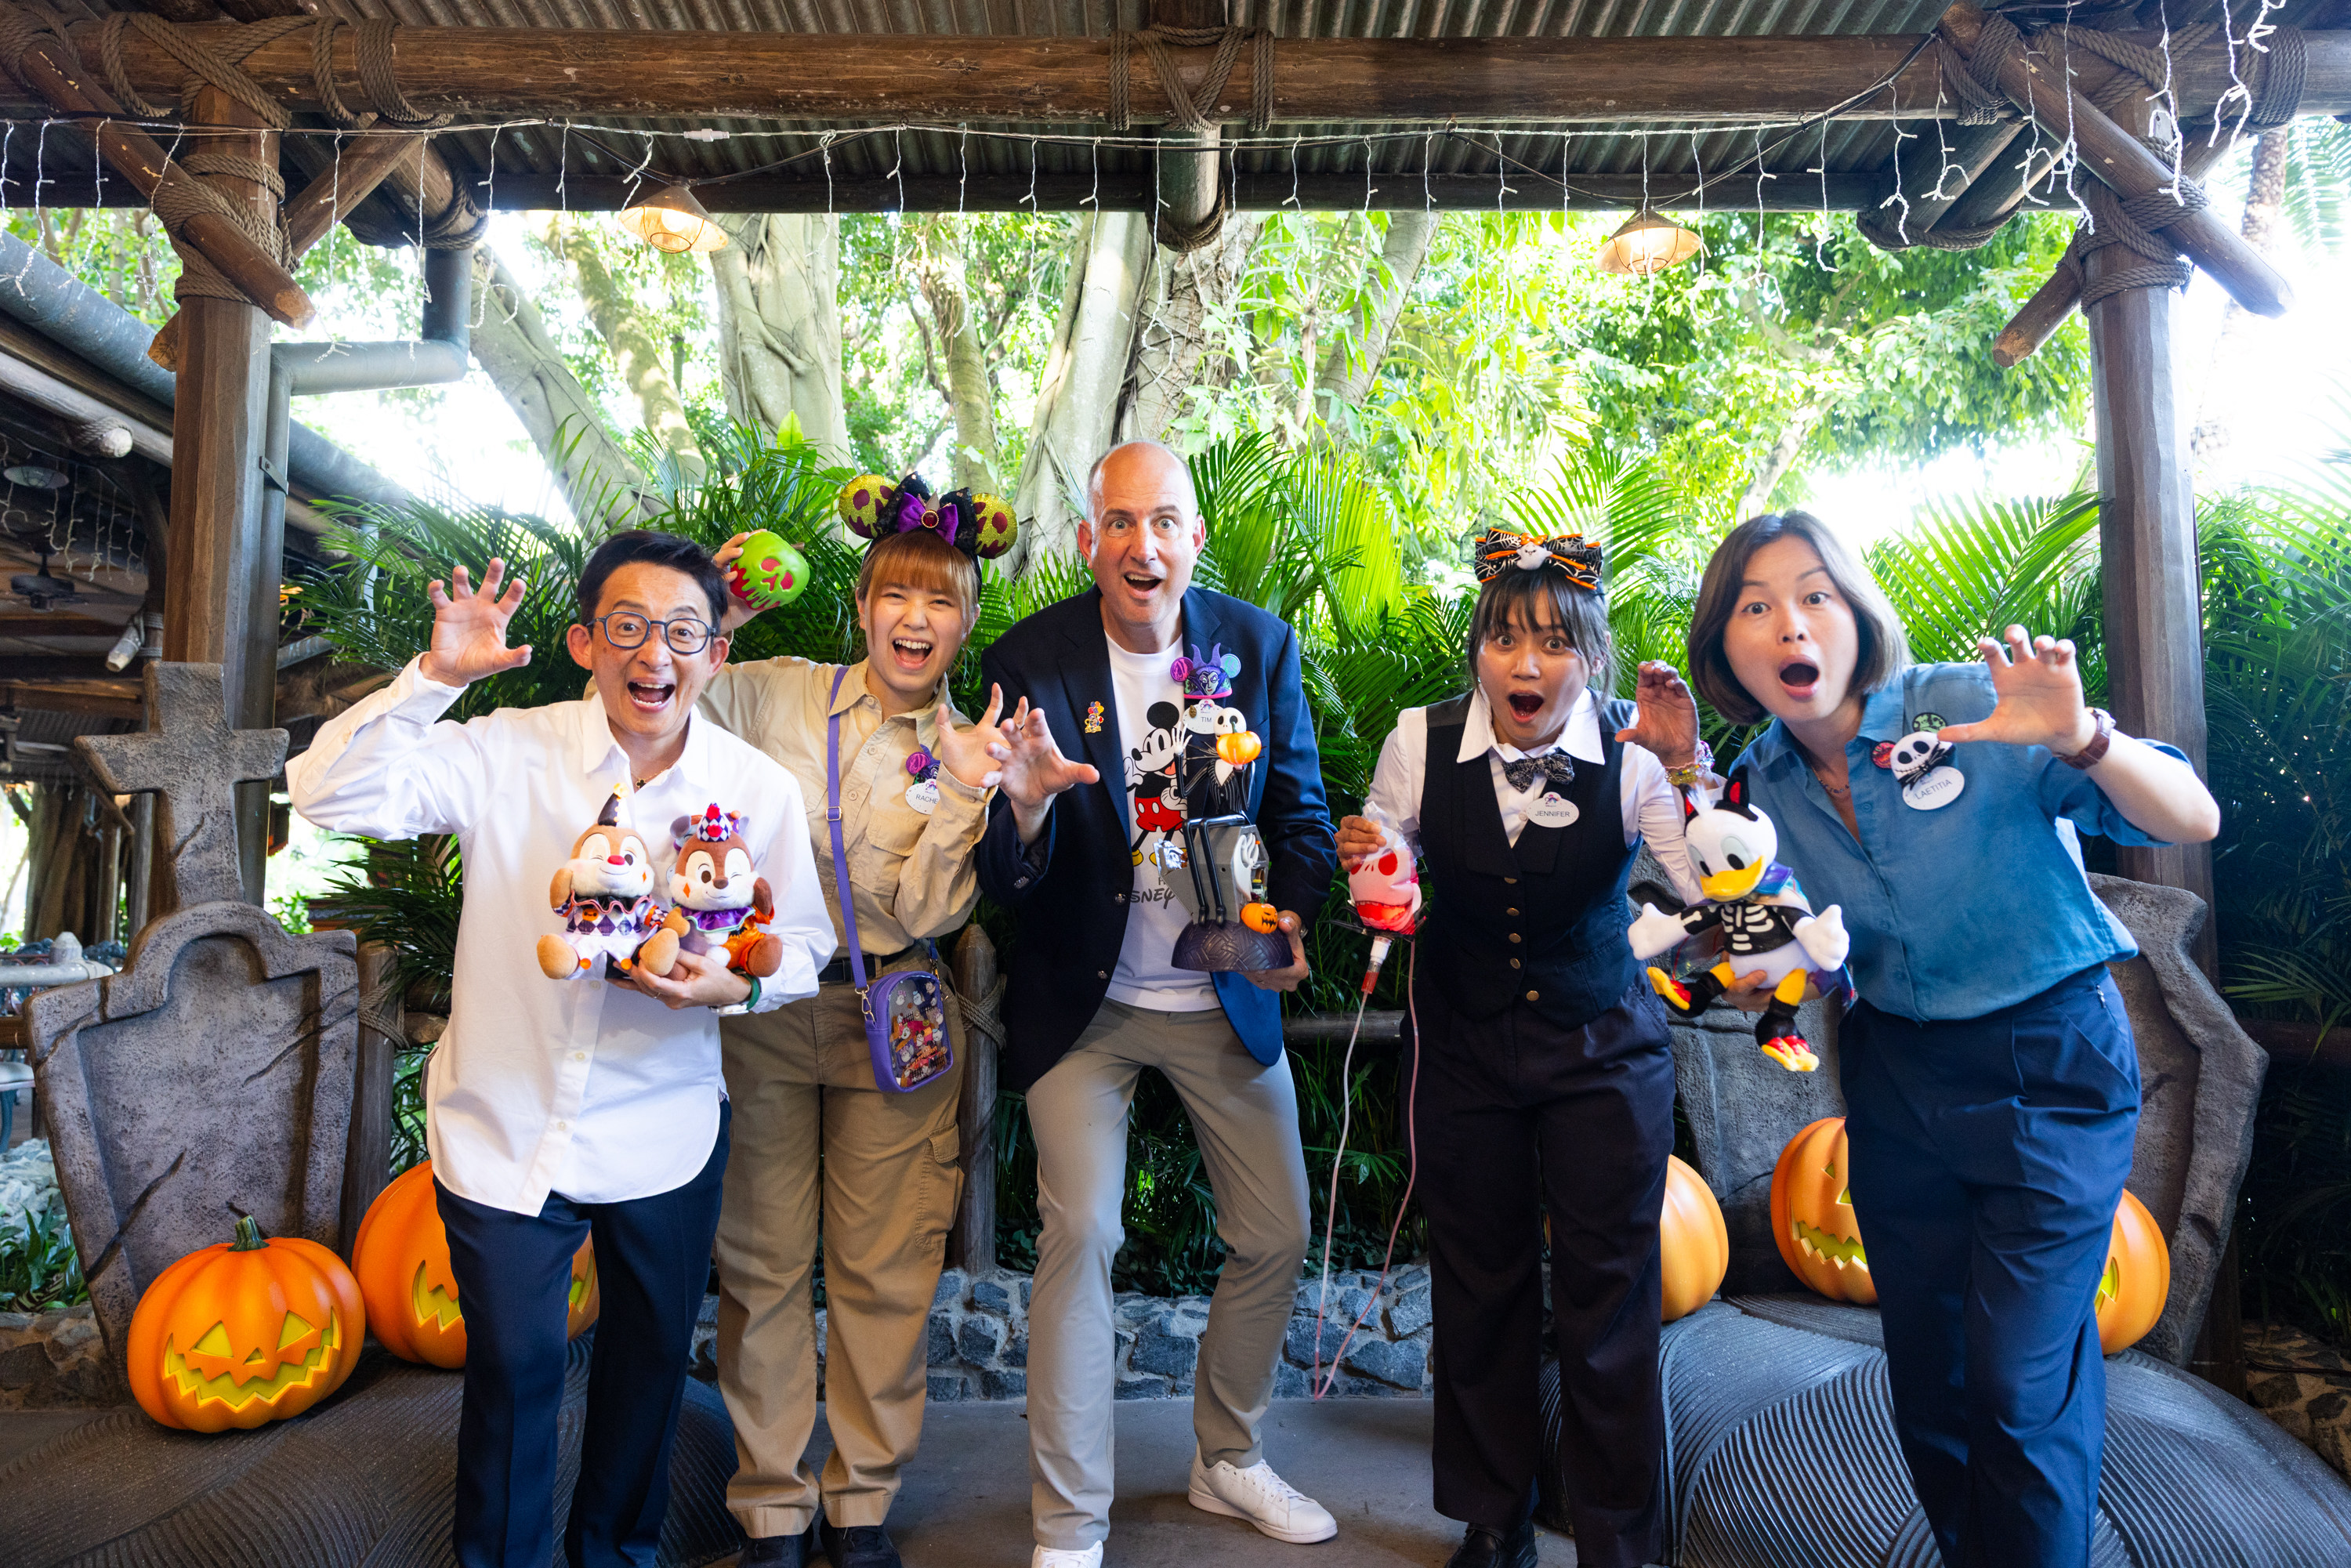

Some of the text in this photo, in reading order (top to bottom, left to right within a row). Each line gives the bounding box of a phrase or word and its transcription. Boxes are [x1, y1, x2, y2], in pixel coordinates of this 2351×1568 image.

[915, 794, 939, 805] RACHE
[1914, 779, 1953, 800] LAETITIA
[1129, 887, 1176, 910] SNEY
